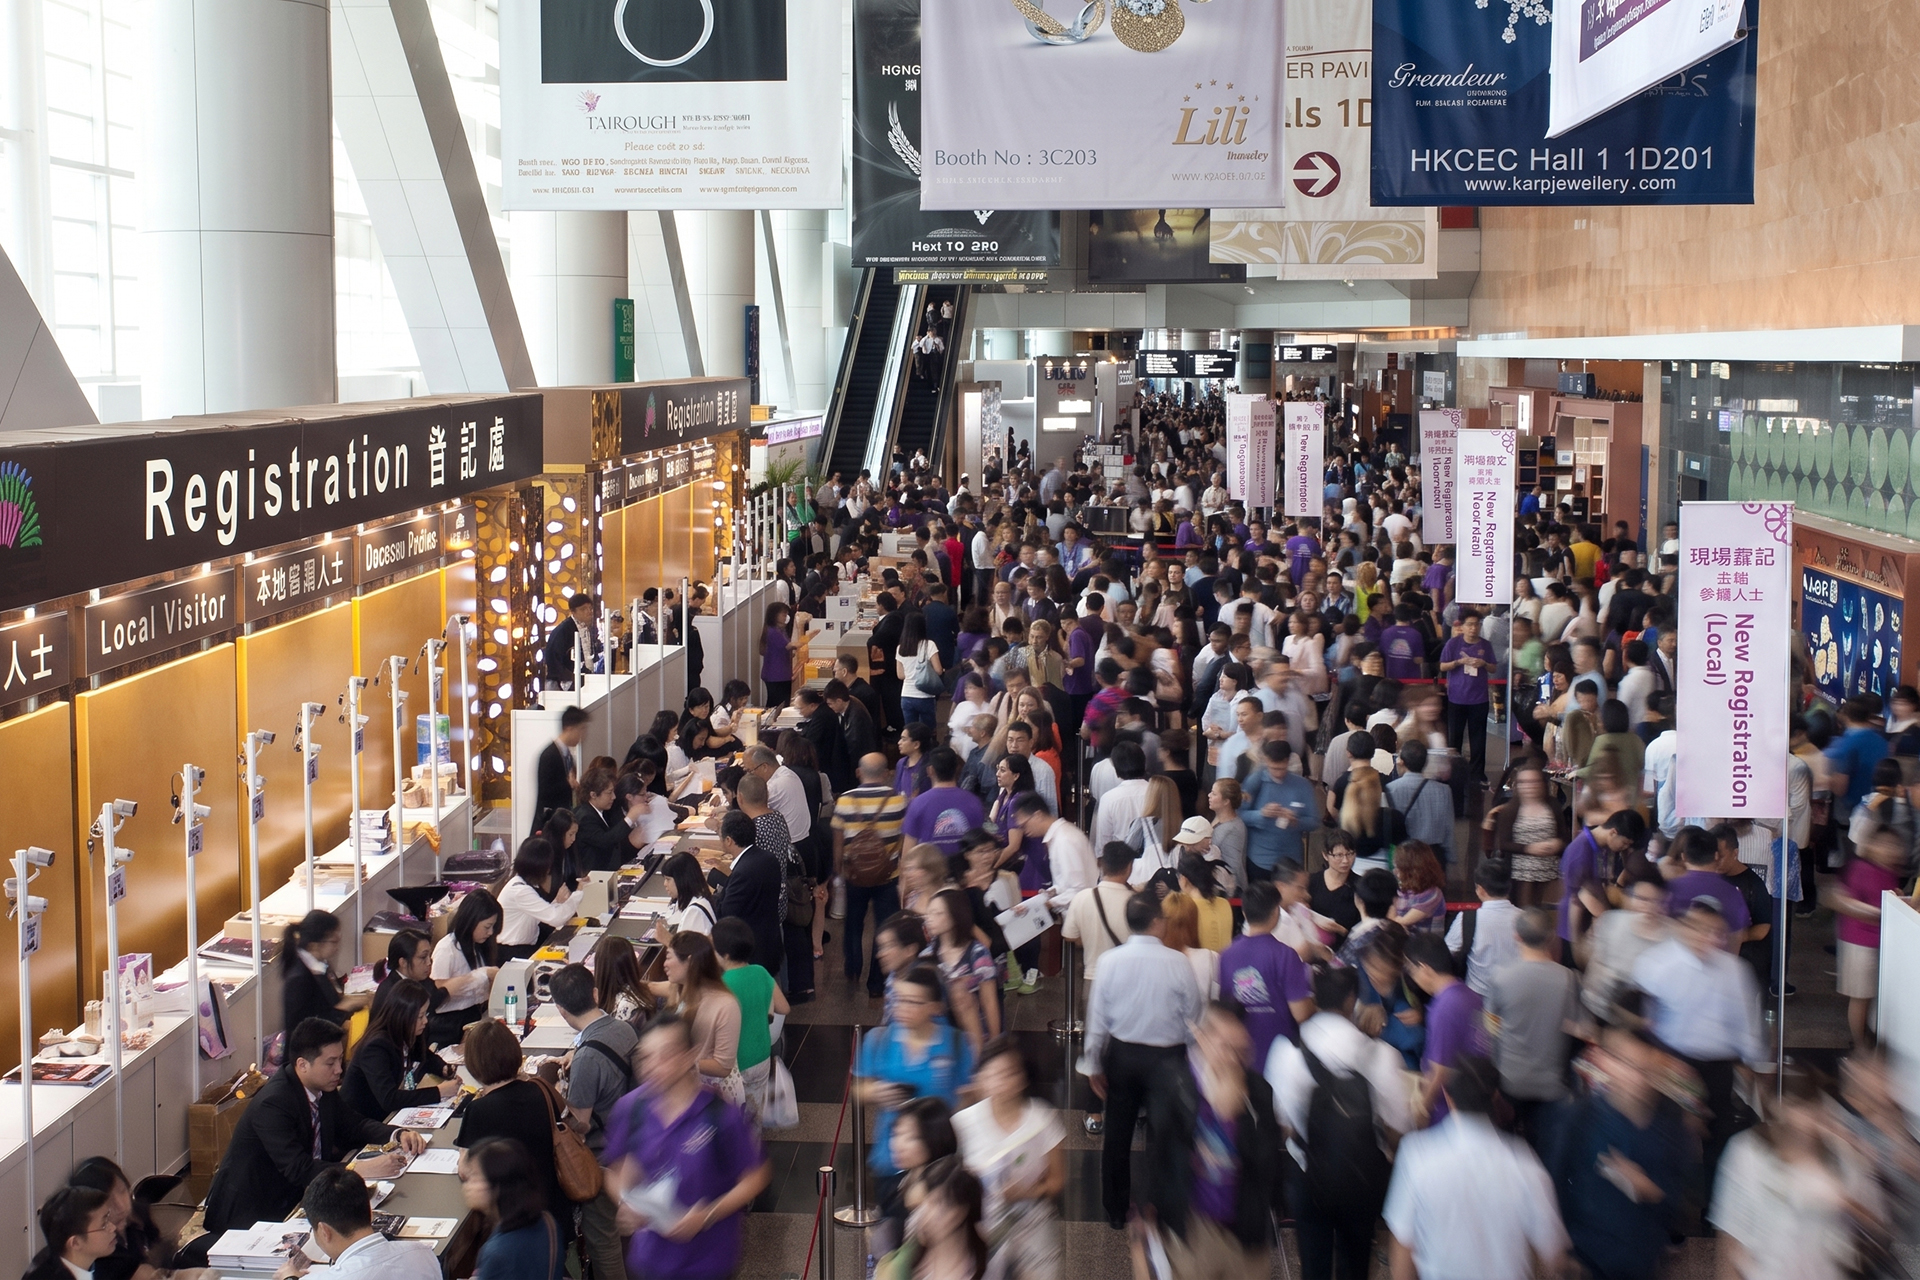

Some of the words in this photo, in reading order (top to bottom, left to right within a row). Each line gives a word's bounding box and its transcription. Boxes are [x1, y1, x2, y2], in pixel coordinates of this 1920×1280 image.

[1287, 62, 1314, 78] ER
[1322, 61, 1368, 78] PAVI
[586, 115, 676, 132] TAIROUGH
[1172, 106, 1250, 145] Lili
[935, 149, 987, 166] Booth
[994, 149, 1021, 166] No
[1039, 149, 1097, 166] 3C203
[1411, 148, 1519, 172] HKCEC
[1530, 148, 1584, 171] Hall
[1597, 148, 1609, 170] 1
[1624, 146, 1713, 170] 1D201
[912, 241, 942, 251] Hext
[947, 241, 965, 251] TO
[667, 395, 714, 437] Registration
[145, 435, 409, 547] Registration
[101, 605, 156, 655] Local
[163, 592, 226, 635] Visitor
[1734, 613, 1755, 662] New
[3, 633, 54, 692] 人士
[1703, 612, 1728, 686] (Local)
